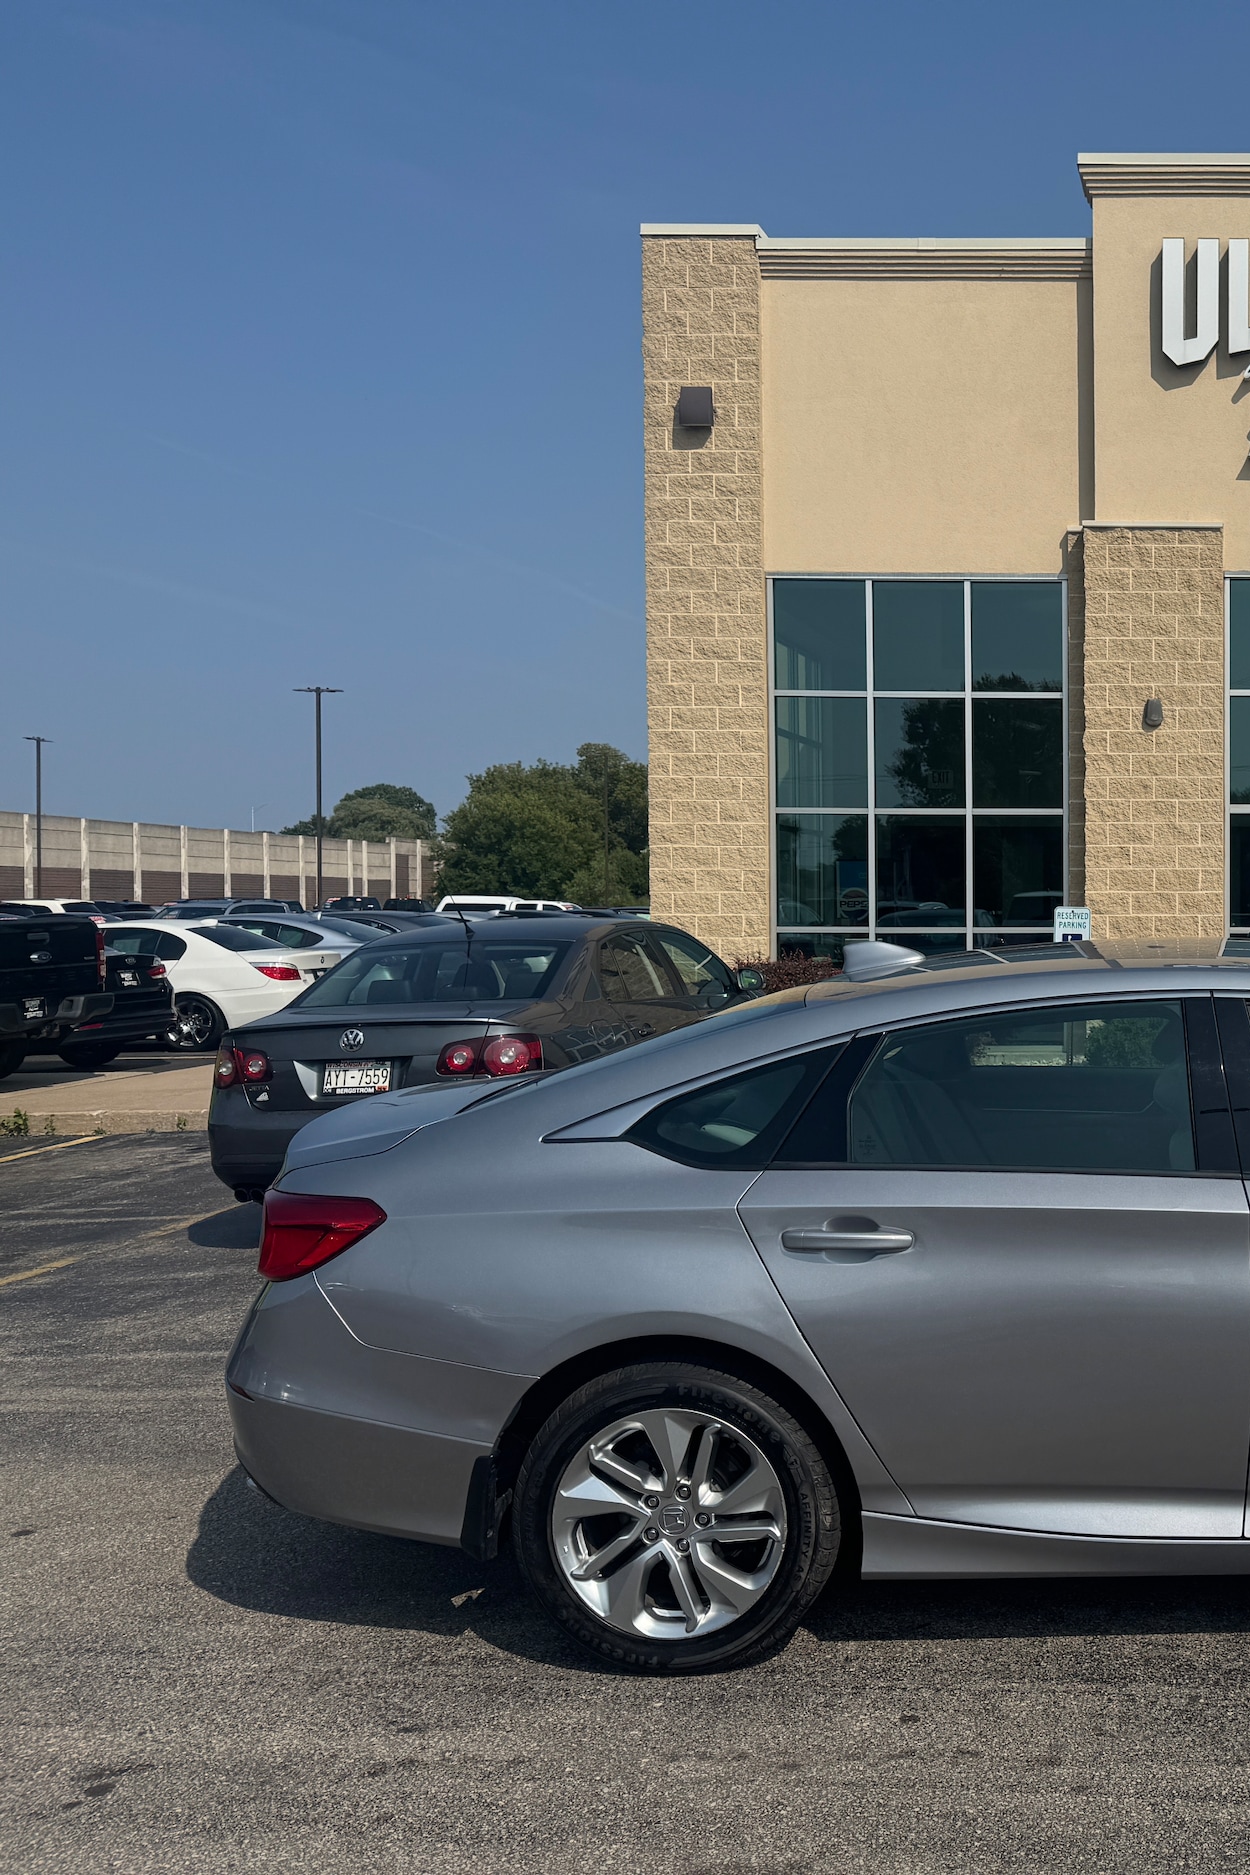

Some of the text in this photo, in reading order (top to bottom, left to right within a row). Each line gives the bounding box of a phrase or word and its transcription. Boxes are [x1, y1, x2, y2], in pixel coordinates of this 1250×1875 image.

[932, 771, 949, 784] EXIT
[840, 900, 867, 908] PEPS
[1057, 911, 1089, 920] RESERVED
[1059, 921, 1087, 929] PARKING
[325, 1068, 389, 1086] AYT-7559
[336, 1086, 375, 1095] BERGSTROM
[799, 1492, 812, 1558] AFFINITY
